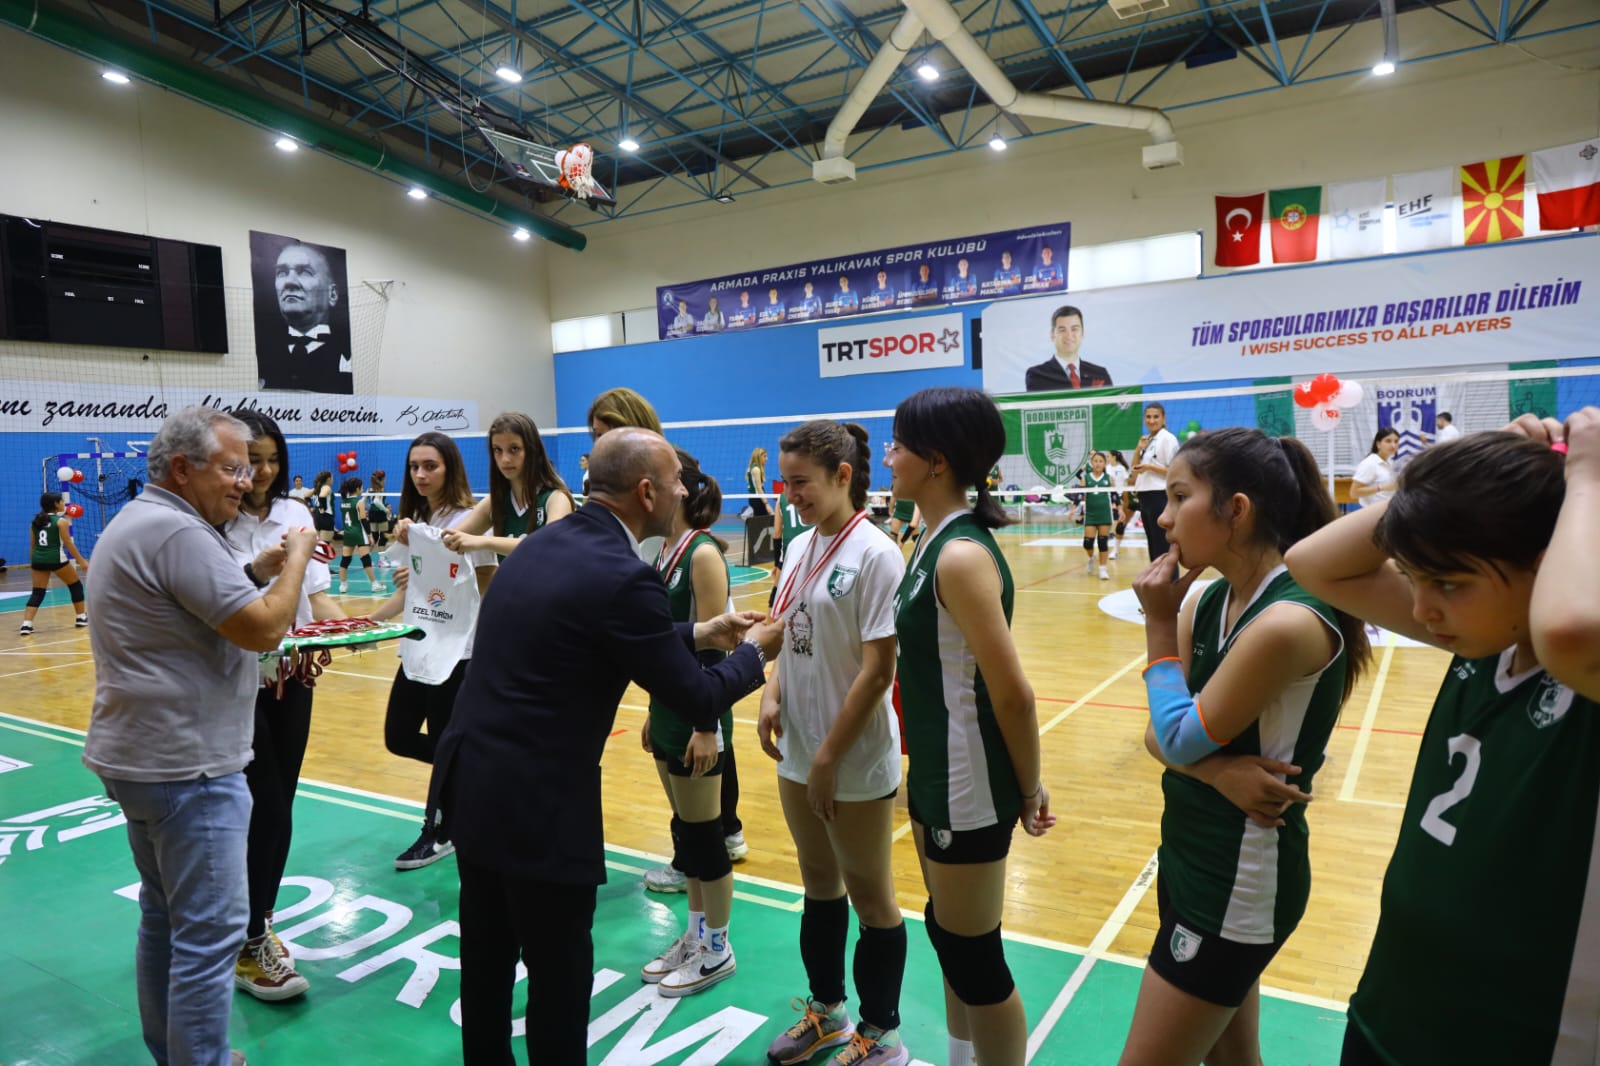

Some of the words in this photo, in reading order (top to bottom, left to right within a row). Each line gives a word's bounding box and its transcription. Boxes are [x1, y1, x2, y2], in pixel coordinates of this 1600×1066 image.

[1399, 194, 1433, 216] EHF
[710, 276, 758, 292] ARMADA
[762, 268, 808, 284] PRAXIS
[811, 255, 881, 276] YALIKAVAK
[886, 250, 922, 265] SPOR
[1191, 321, 1225, 347] TÜM
[1228, 305, 1378, 343] SPORCULARIMIZA
[1382, 291, 1491, 326] BAŞARILAR
[1495, 277, 1582, 313] DİLERİM
[1241, 345, 1247, 356] I
[1249, 340, 1290, 356] WISH
[1293, 332, 1368, 351] SUCCESS
[1371, 329, 1394, 343] TO
[1397, 325, 1428, 340] ALL
[1431, 316, 1512, 336] PLAYERS
[1377, 387, 1436, 399] BODRUM
[42, 395, 168, 427] zamanda
[310, 406, 383, 423] severim.
[1026, 409, 1087, 422] BODRUMSPOR
[344, 511, 353, 527] 4
[39, 530, 48, 546] 8
[412, 607, 430, 616] EZEL
[1420, 733, 1482, 846] 2
